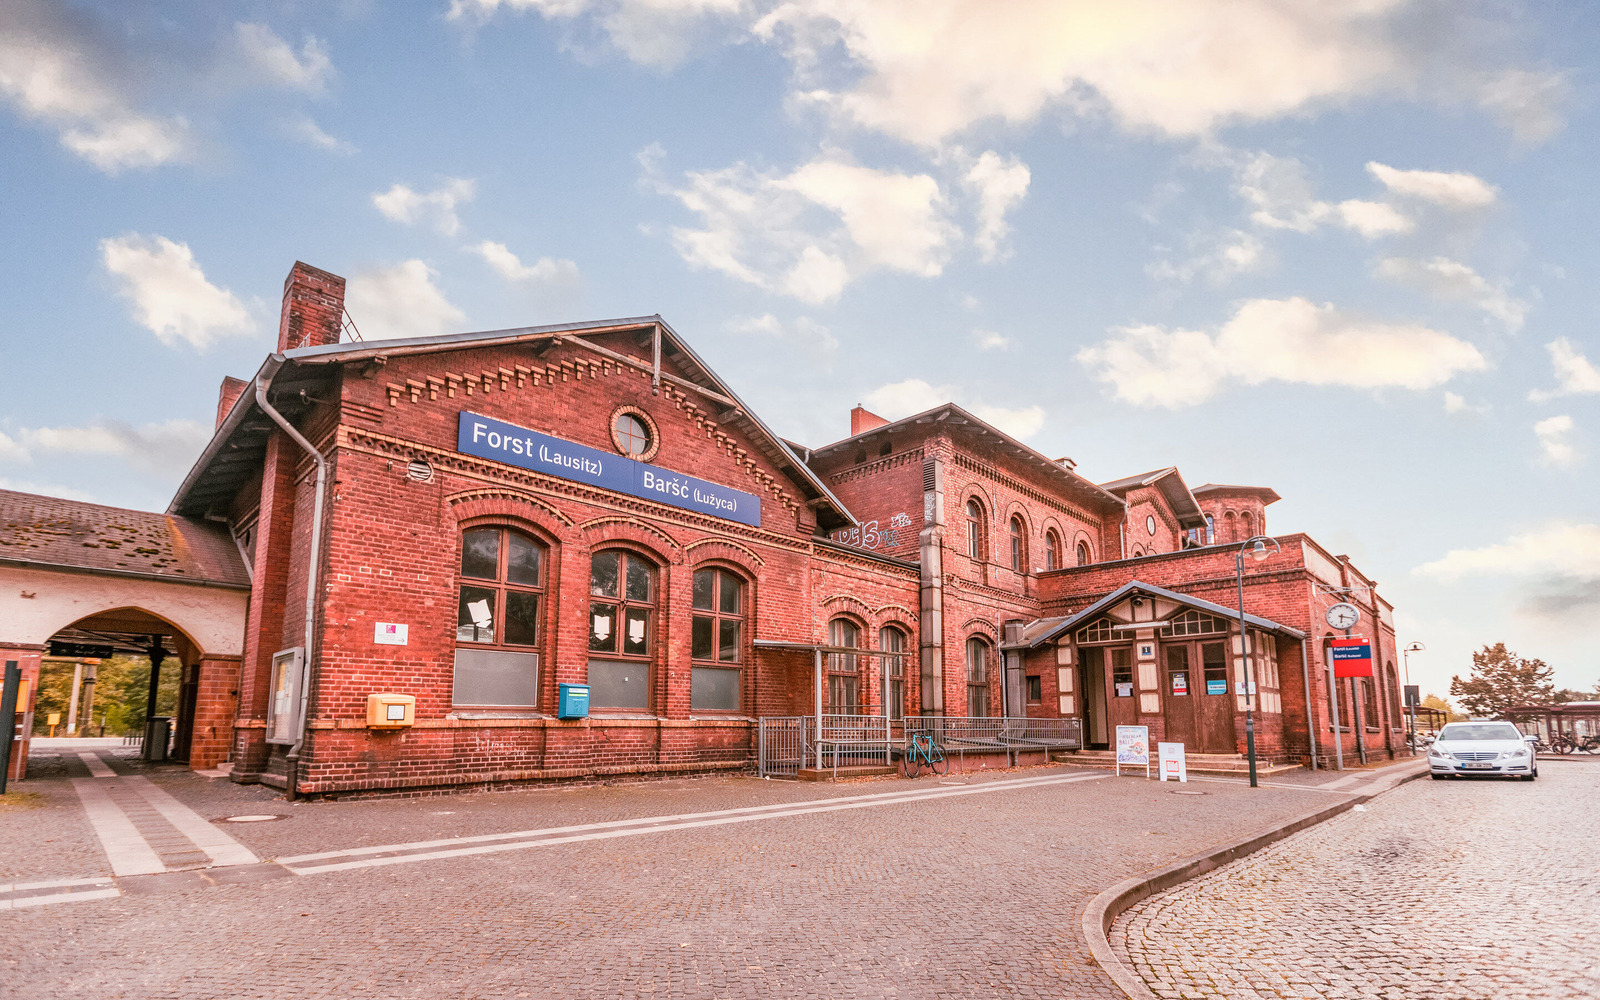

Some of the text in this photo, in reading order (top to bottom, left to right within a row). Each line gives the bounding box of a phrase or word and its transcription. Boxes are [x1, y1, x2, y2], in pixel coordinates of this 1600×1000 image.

[473, 422, 602, 477] Forst (Lausitz)
[643, 471, 689, 498] Baršć
